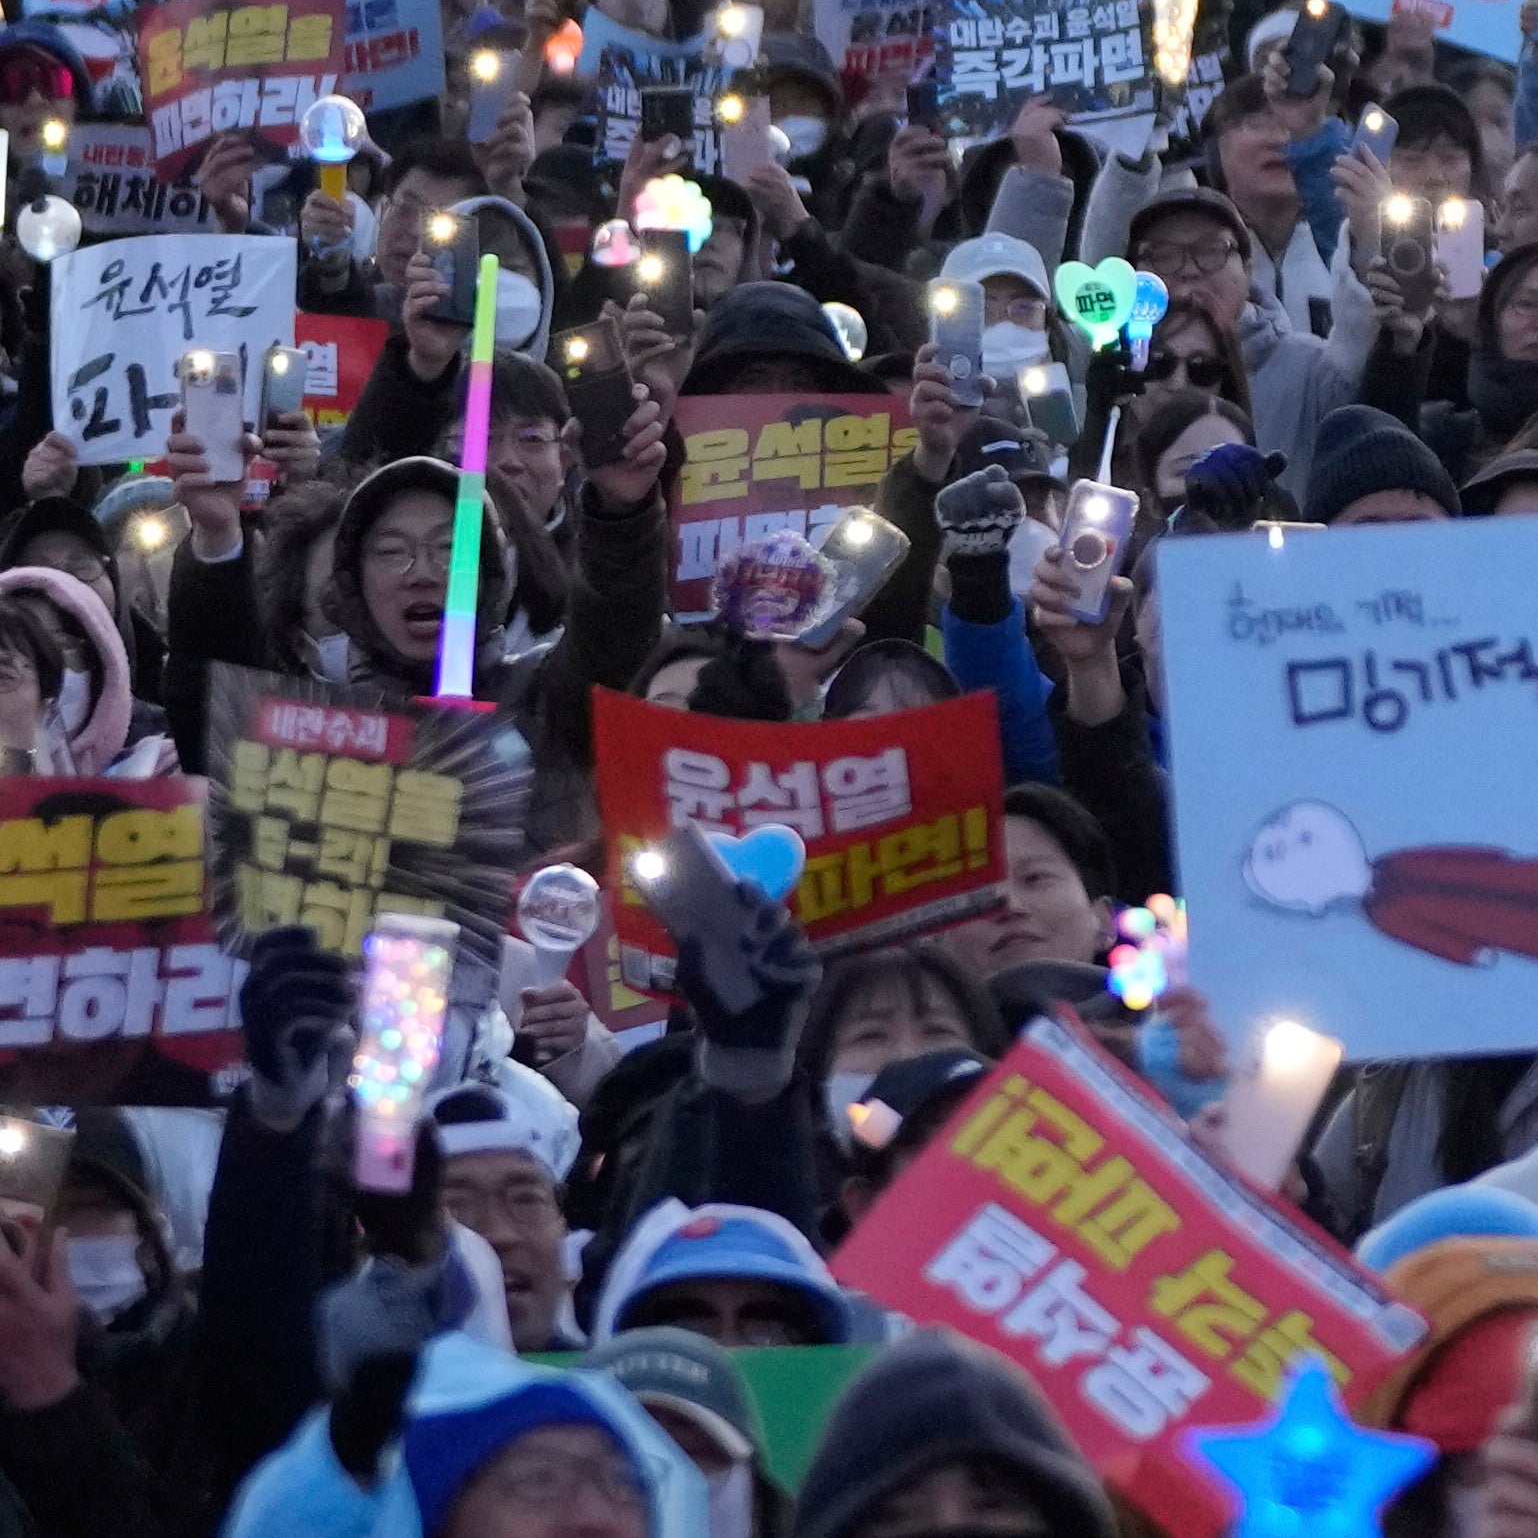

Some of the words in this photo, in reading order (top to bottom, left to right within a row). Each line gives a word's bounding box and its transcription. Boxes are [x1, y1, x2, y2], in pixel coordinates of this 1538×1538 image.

[949, 8, 1062, 48] 내란수괴
[949, 30, 1146, 100] 즉각파면
[73, 171, 209, 225] 해체하
[80, 252, 258, 341] 윤석열
[663, 745, 913, 845] 윤석열
[798, 805, 990, 927] 파면!
[948, 1072, 1186, 1272] 파면!
[926, 1199, 1214, 1445] 윤석열
